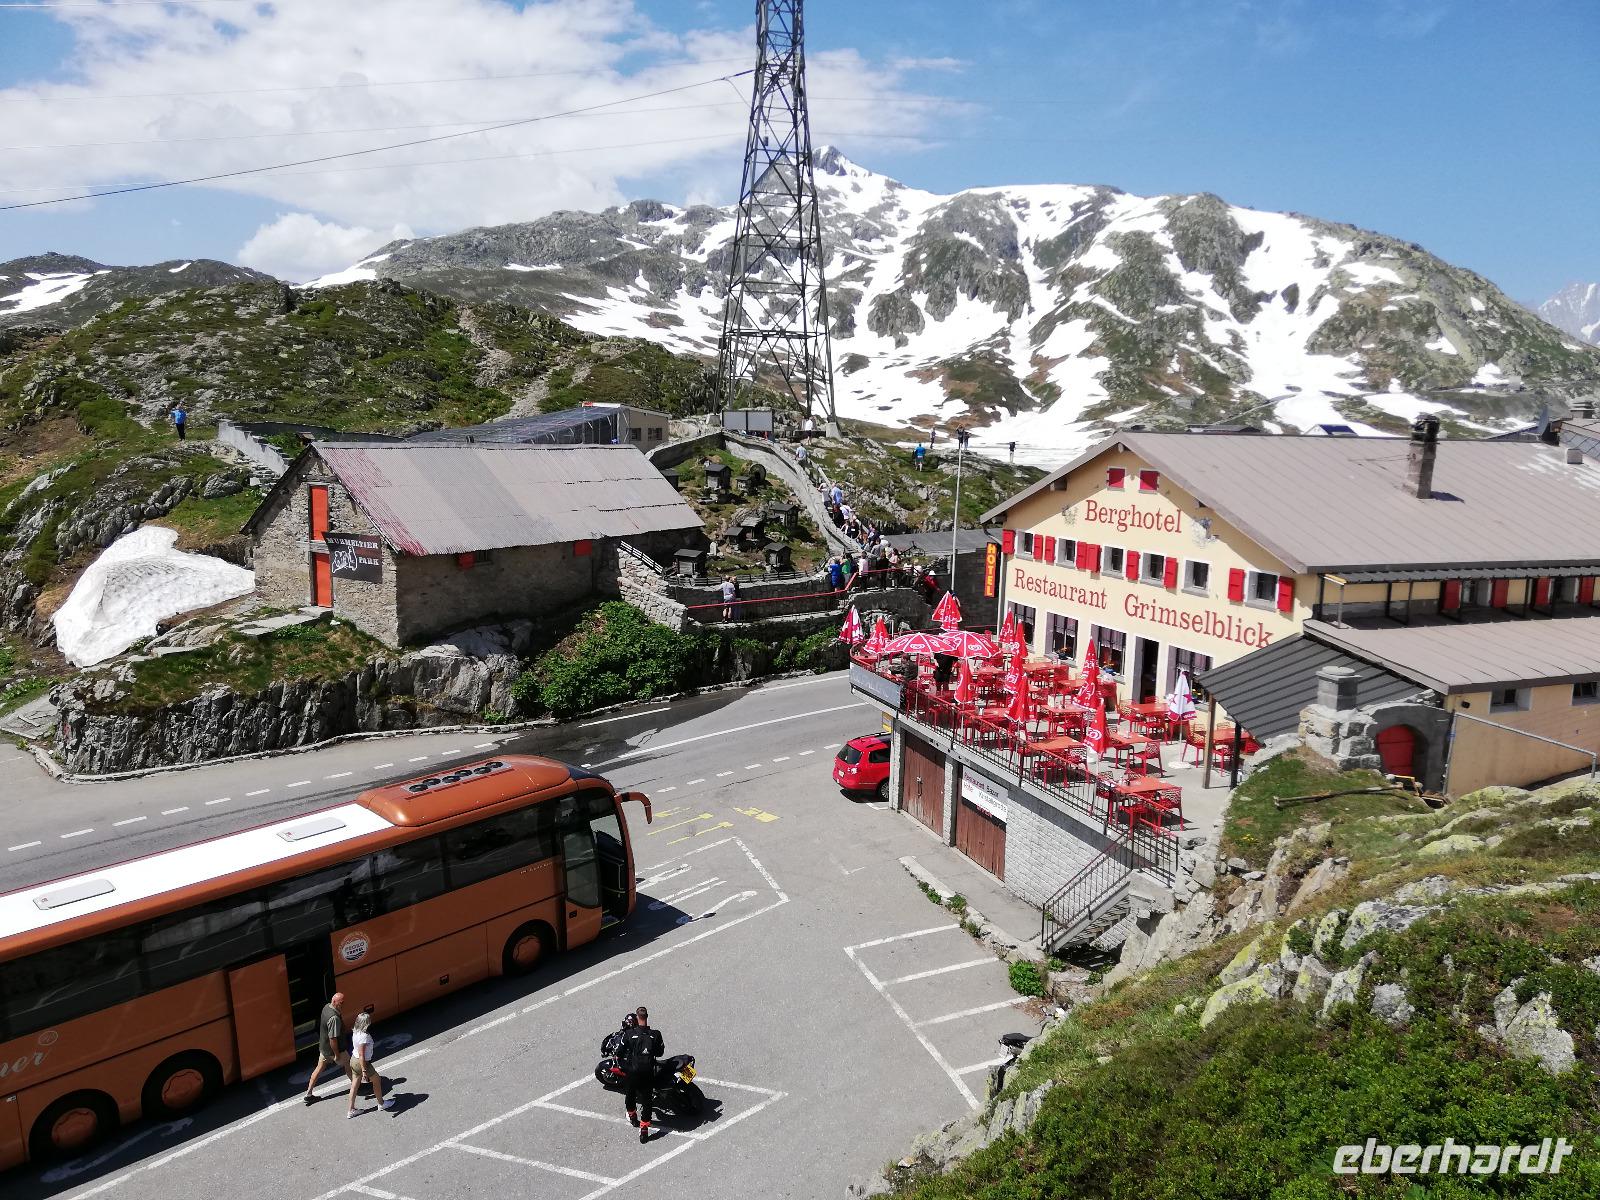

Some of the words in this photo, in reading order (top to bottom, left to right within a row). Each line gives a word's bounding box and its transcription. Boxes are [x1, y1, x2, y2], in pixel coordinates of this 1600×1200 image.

[1085, 499, 1182, 533] Berghotel
[326, 537, 379, 549] MURMELTIER
[358, 556, 380, 566] PARK
[986, 543, 996, 596] HOTEL
[1014, 568, 1107, 610] Restaurant
[1124, 593, 1274, 649] Grimselblick
